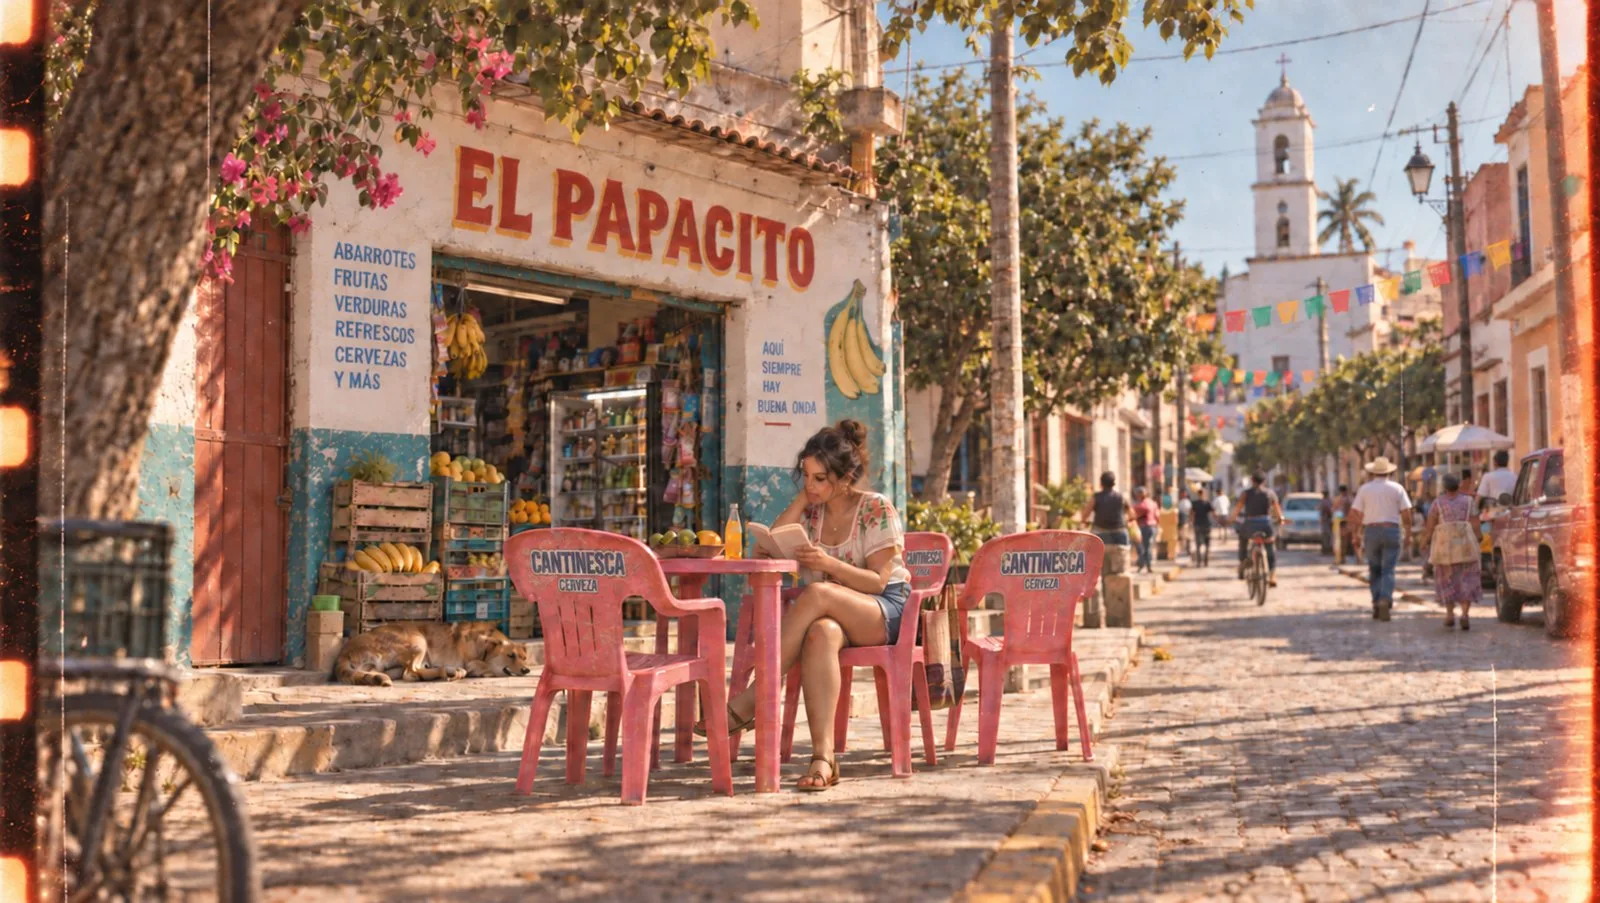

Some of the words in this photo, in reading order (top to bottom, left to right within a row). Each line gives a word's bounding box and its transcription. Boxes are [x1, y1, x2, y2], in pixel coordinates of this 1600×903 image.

[453, 145, 532, 241] EL
[549, 169, 816, 293] PAPACITO
[334, 241, 416, 270] ABARROTES
[334, 268, 388, 291] FRUTAS
[334, 294, 407, 318] VERDURAS
[335, 320, 415, 344] REFRESCOS
[335, 346, 407, 367] CERVEZAS
[762, 361, 802, 376] SIEMPRE
[334, 371, 345, 388] Y
[349, 370, 381, 390] MÁS
[762, 380, 781, 393] HAY
[757, 399, 788, 413] BUENA
[792, 400, 817, 414] ONDA
[531, 550, 626, 576] CANTINESCA
[1001, 551, 1085, 575] CANTINESCA
[559, 578, 598, 592] CERVEZA
[1024, 578, 1059, 590] CERVEZA
